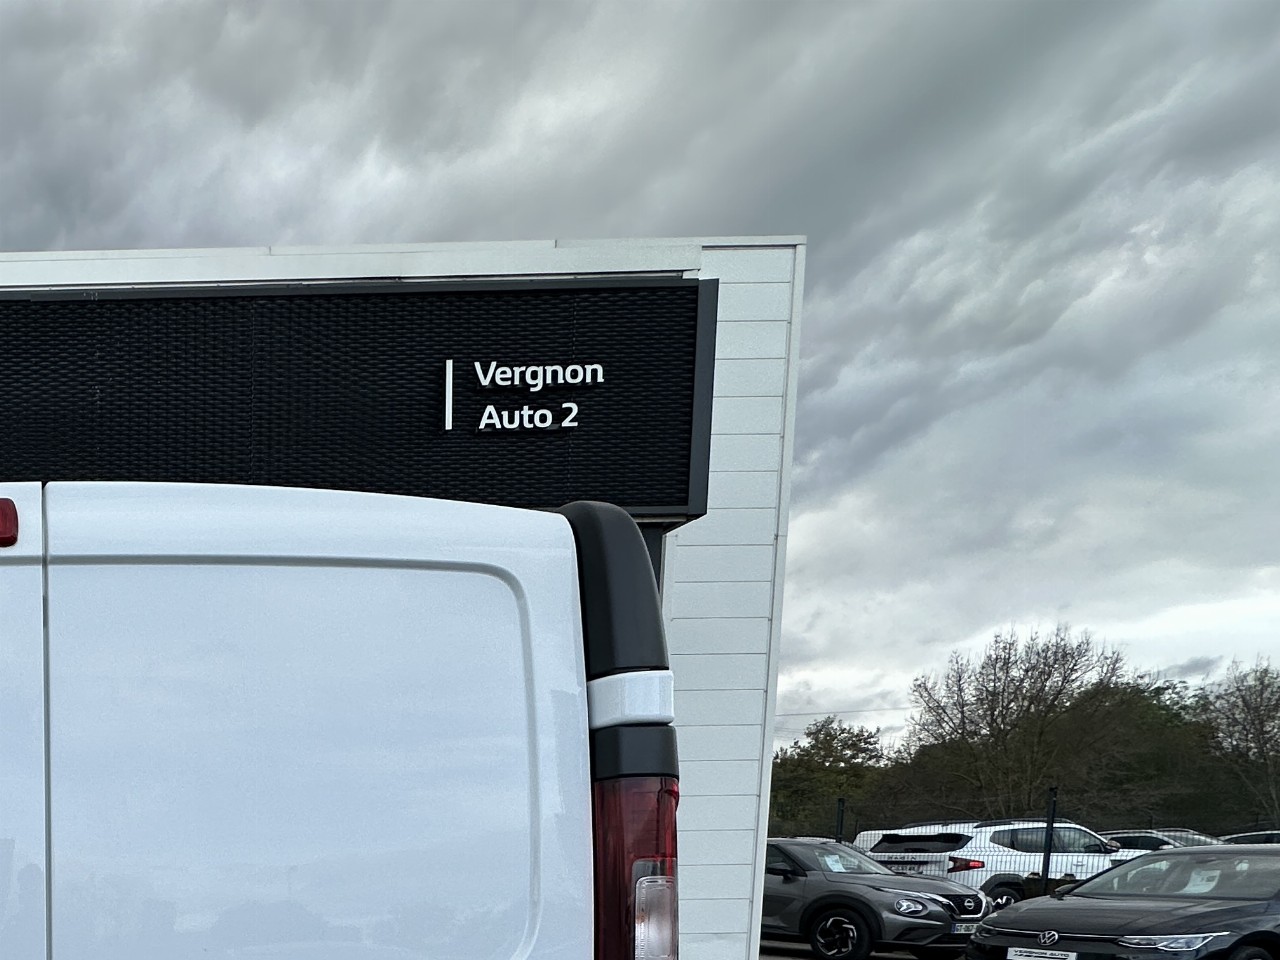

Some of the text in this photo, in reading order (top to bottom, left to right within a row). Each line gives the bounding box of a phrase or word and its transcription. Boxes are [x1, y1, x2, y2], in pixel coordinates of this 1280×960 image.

[474, 361, 604, 392] Vergnon
[478, 402, 579, 429] Auto 2
